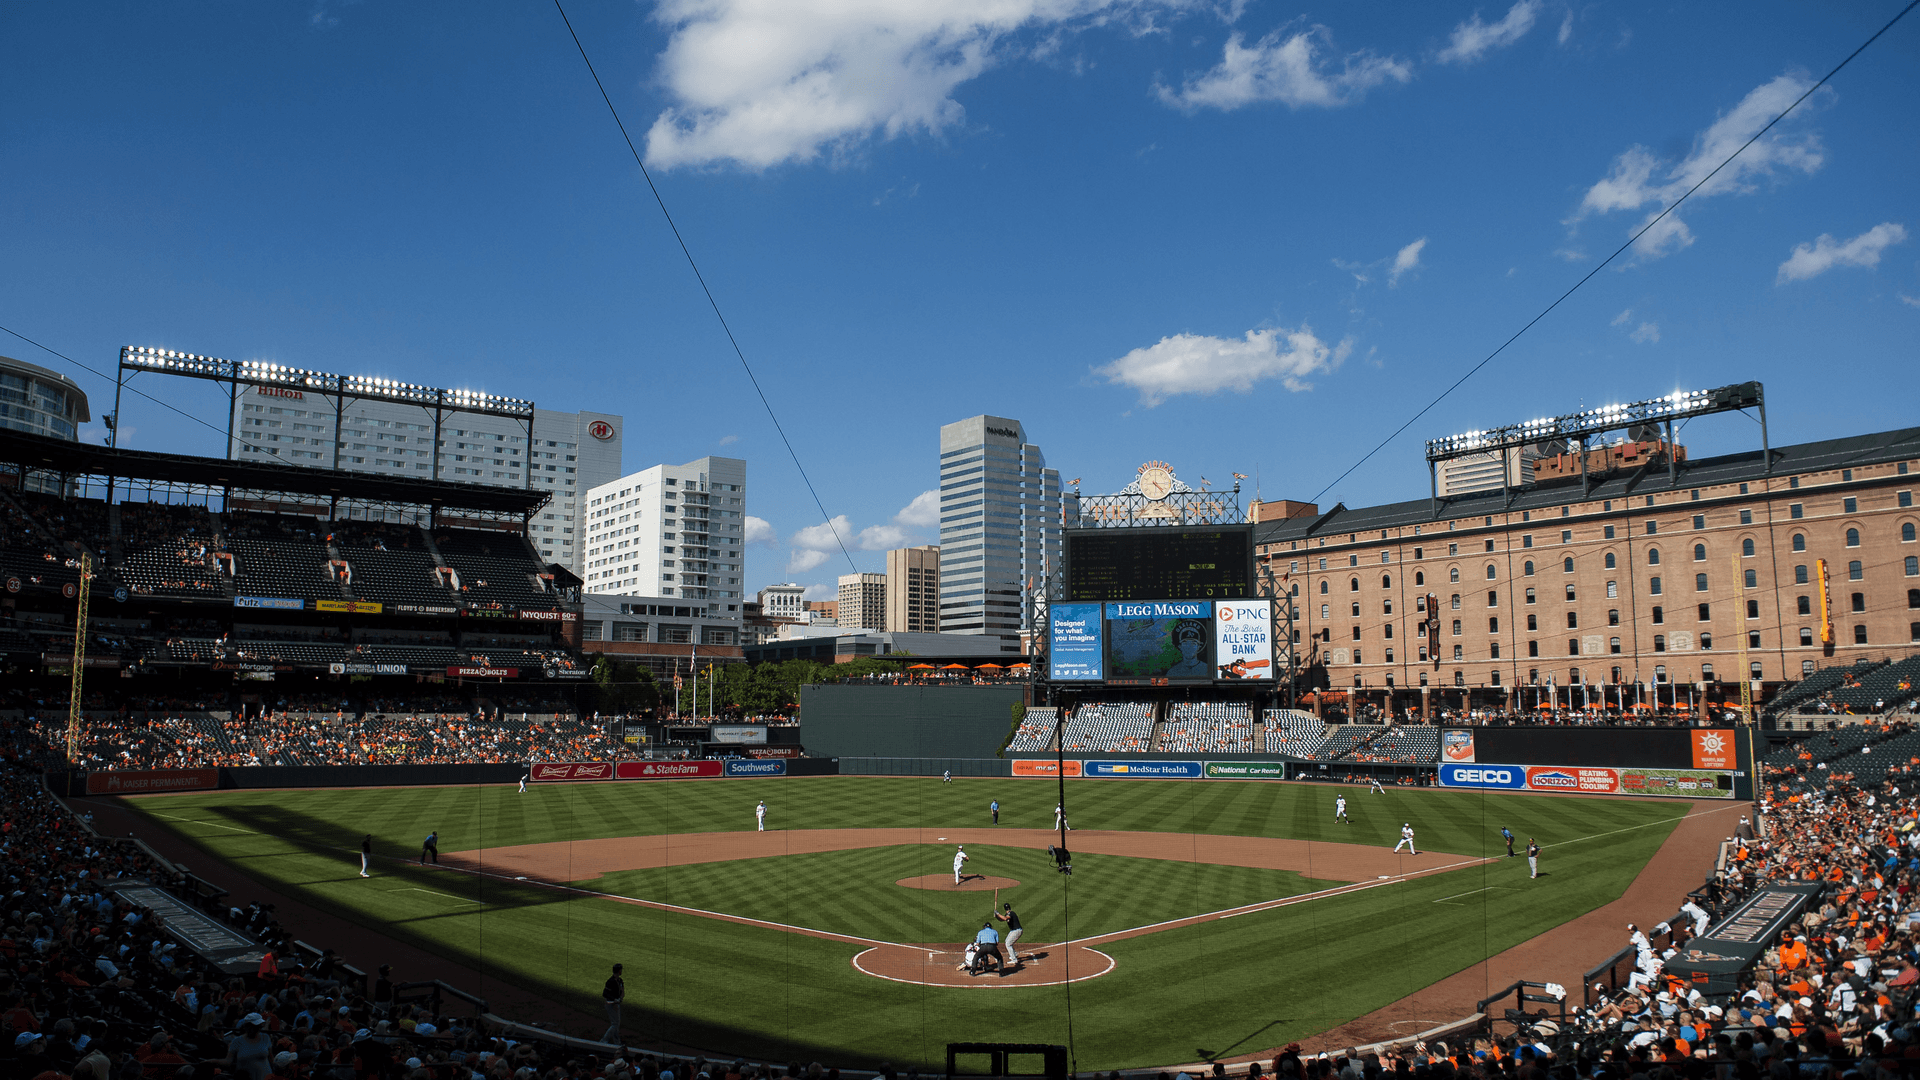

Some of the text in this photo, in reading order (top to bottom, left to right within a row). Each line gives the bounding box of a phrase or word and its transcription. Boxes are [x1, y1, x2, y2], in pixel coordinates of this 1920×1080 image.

[257, 386, 303, 399] Hilton
[1137, 460, 1174, 474] ORIOLES
[1091, 501, 1223, 520] THE SUN
[67, 586, 73, 595] 8
[1118, 604, 1199, 616] LEGG MASON
[1237, 608, 1268, 619] PNC
[522, 611, 557, 620] NYQUIST
[1225, 624, 1263, 633] The Birds
[1222, 633, 1266, 644] ALL-STAR
[1232, 644, 1256, 655] BANK
[376, 664, 407, 673] UNION
[731, 763, 775, 772] Southwest
[1130, 766, 1188, 774] MedStar Health
[1218, 766, 1247, 774] National
[1453, 768, 1512, 784] GEICO
[1579, 776, 1614, 784] PLUMBING
[123, 777, 199, 788] KAISER PERMANENTE
[1533, 777, 1577, 786] HORIZON
